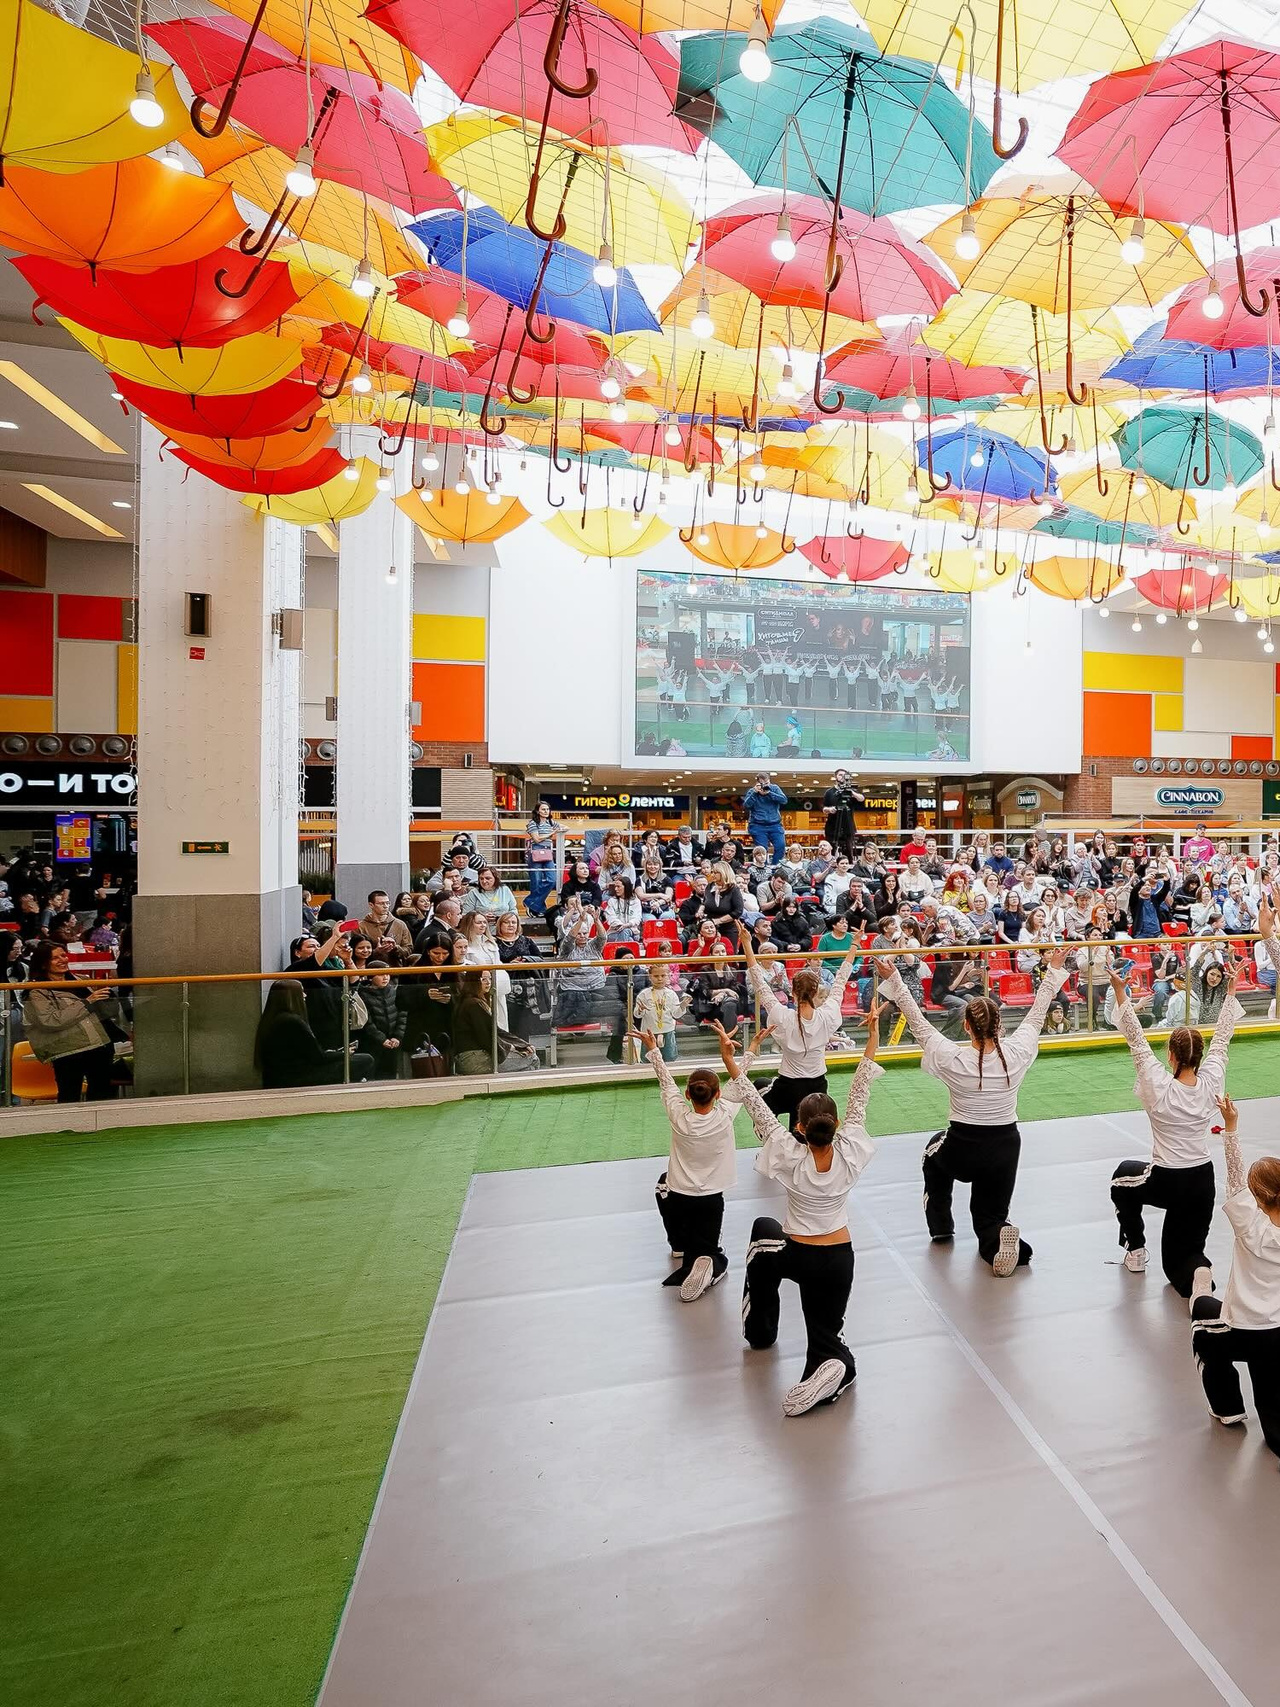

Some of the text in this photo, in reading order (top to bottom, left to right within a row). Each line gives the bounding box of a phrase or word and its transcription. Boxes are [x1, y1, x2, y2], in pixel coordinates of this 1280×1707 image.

[575, 795, 675, 809] гипер лента
[1160, 791, 1220, 802] CINNABON
